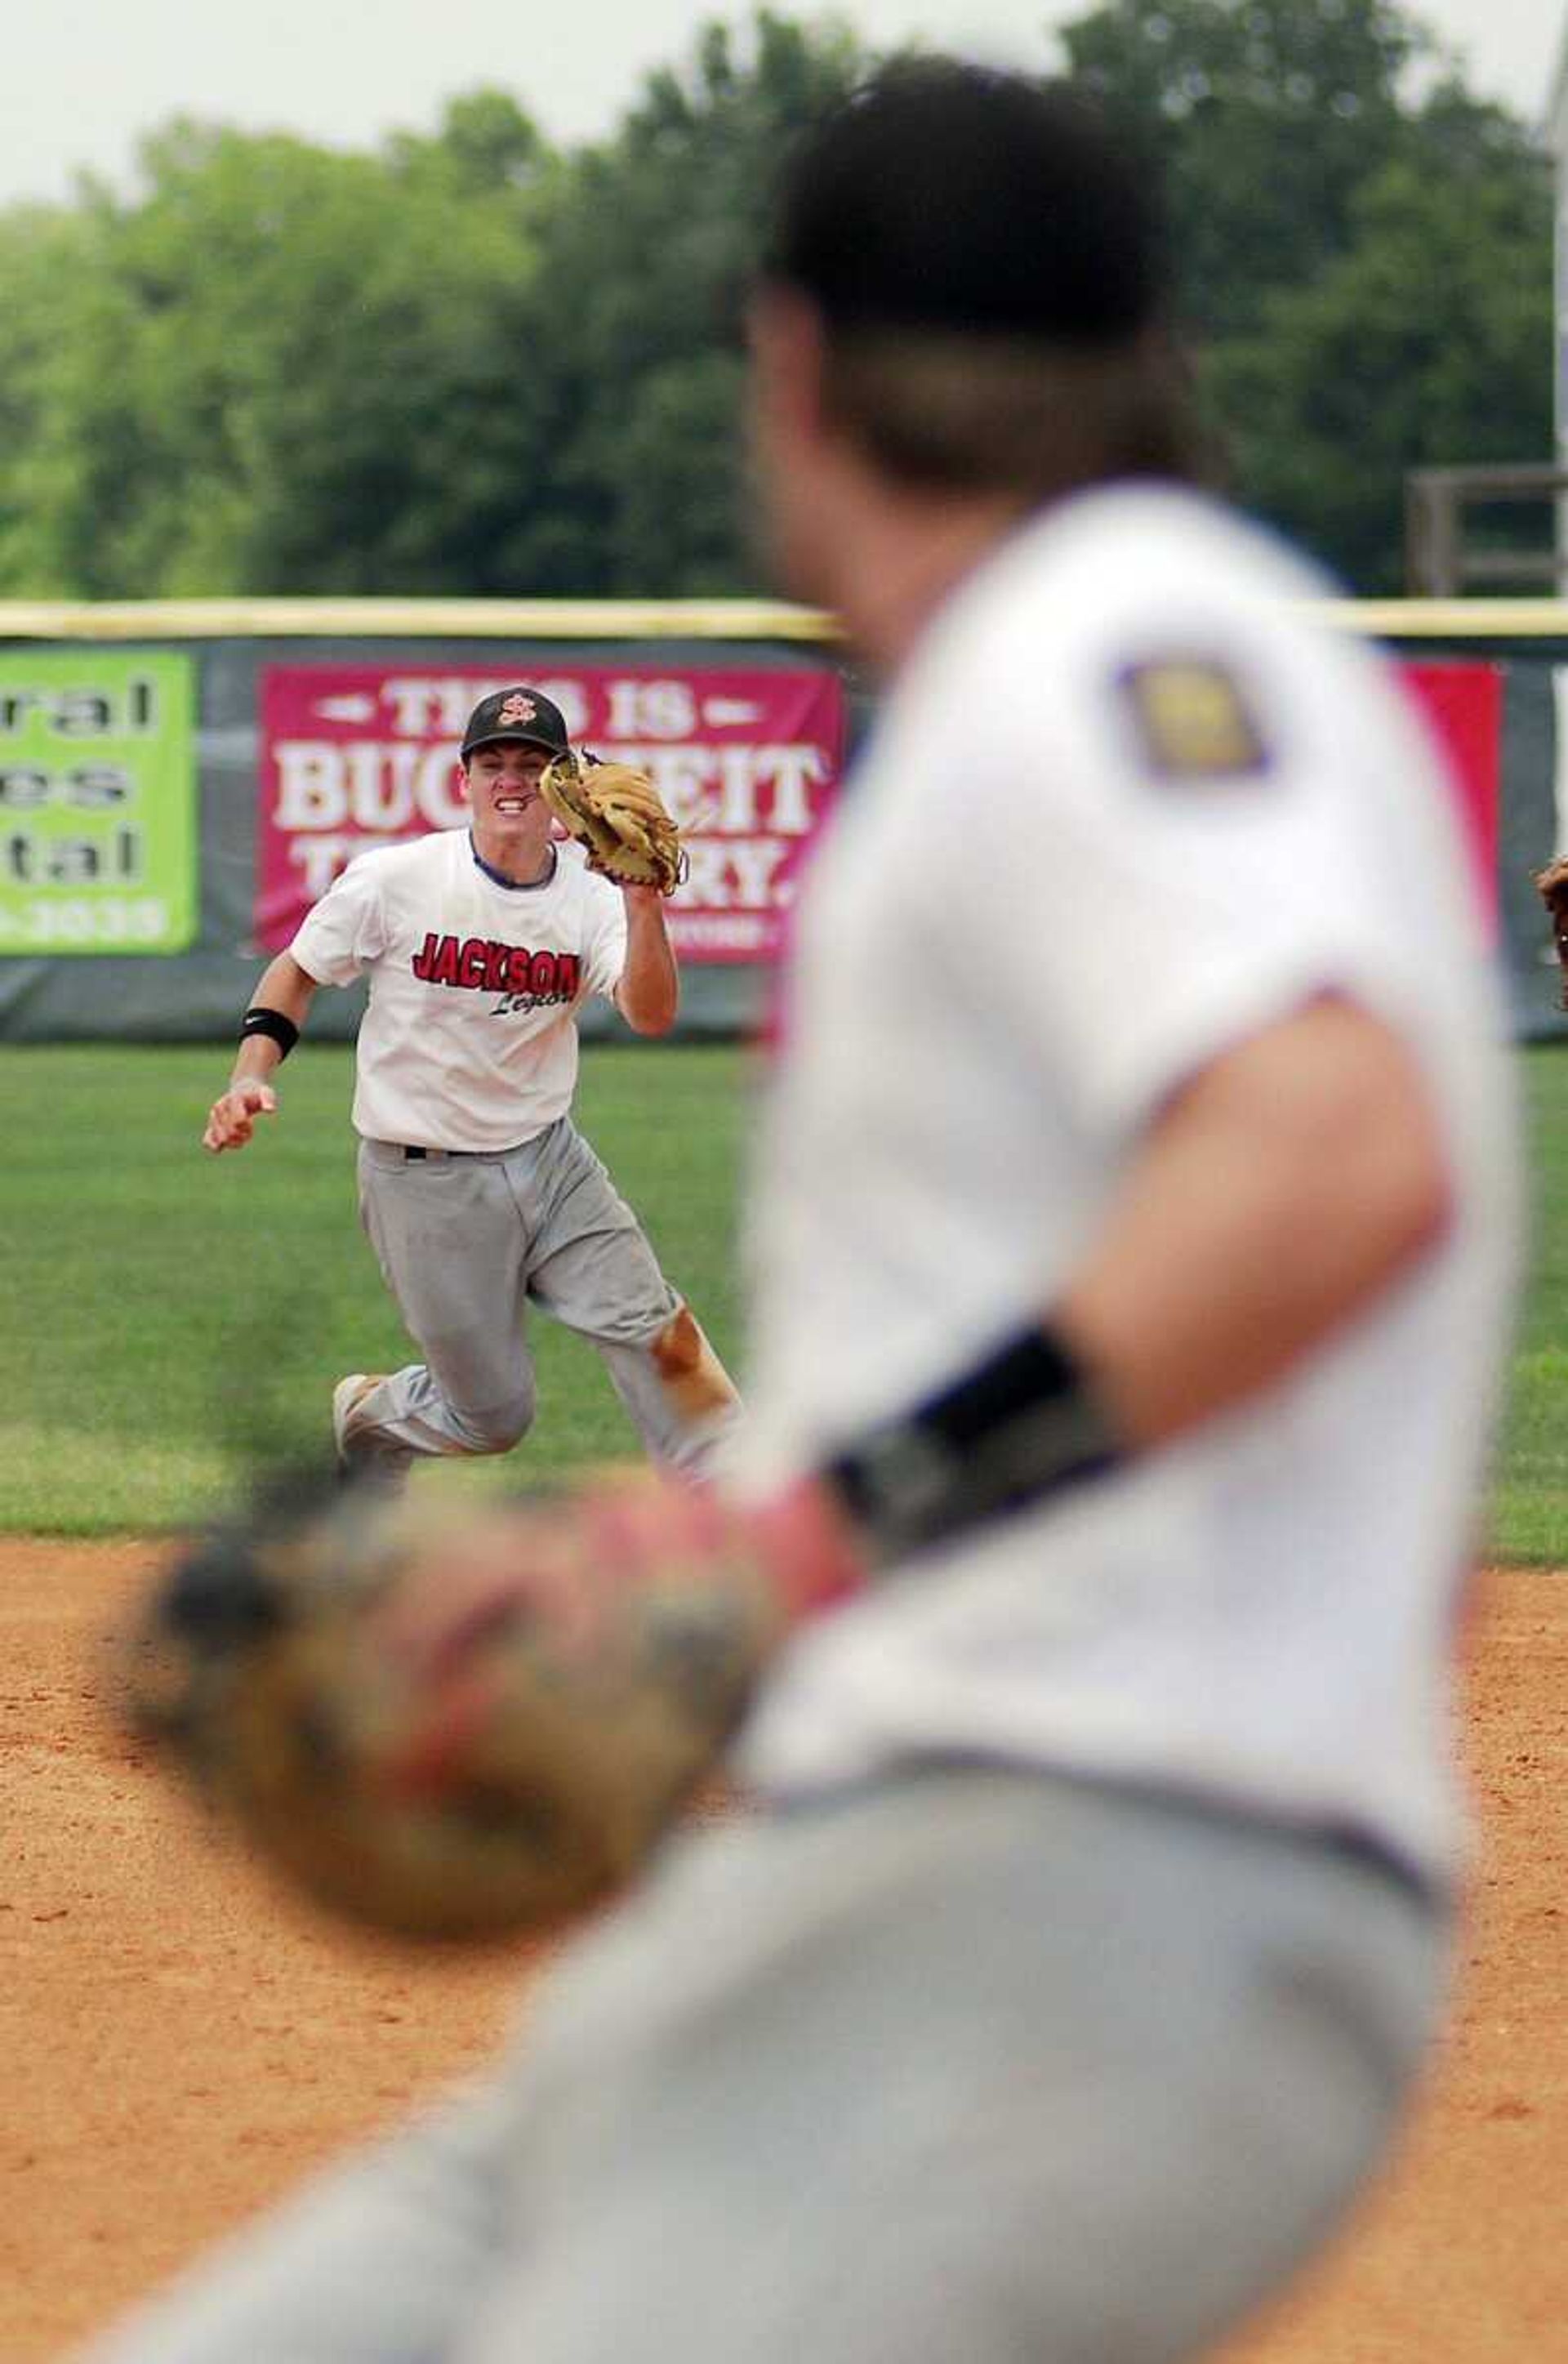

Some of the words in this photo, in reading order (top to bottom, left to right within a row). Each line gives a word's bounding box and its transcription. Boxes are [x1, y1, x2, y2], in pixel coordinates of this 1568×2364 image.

[379, 676, 590, 735] THS
[608, 676, 694, 737] IS
[272, 742, 831, 833] BUCEIT
[8, 827, 134, 882] tal
[411, 931, 581, 998] JACKSON
